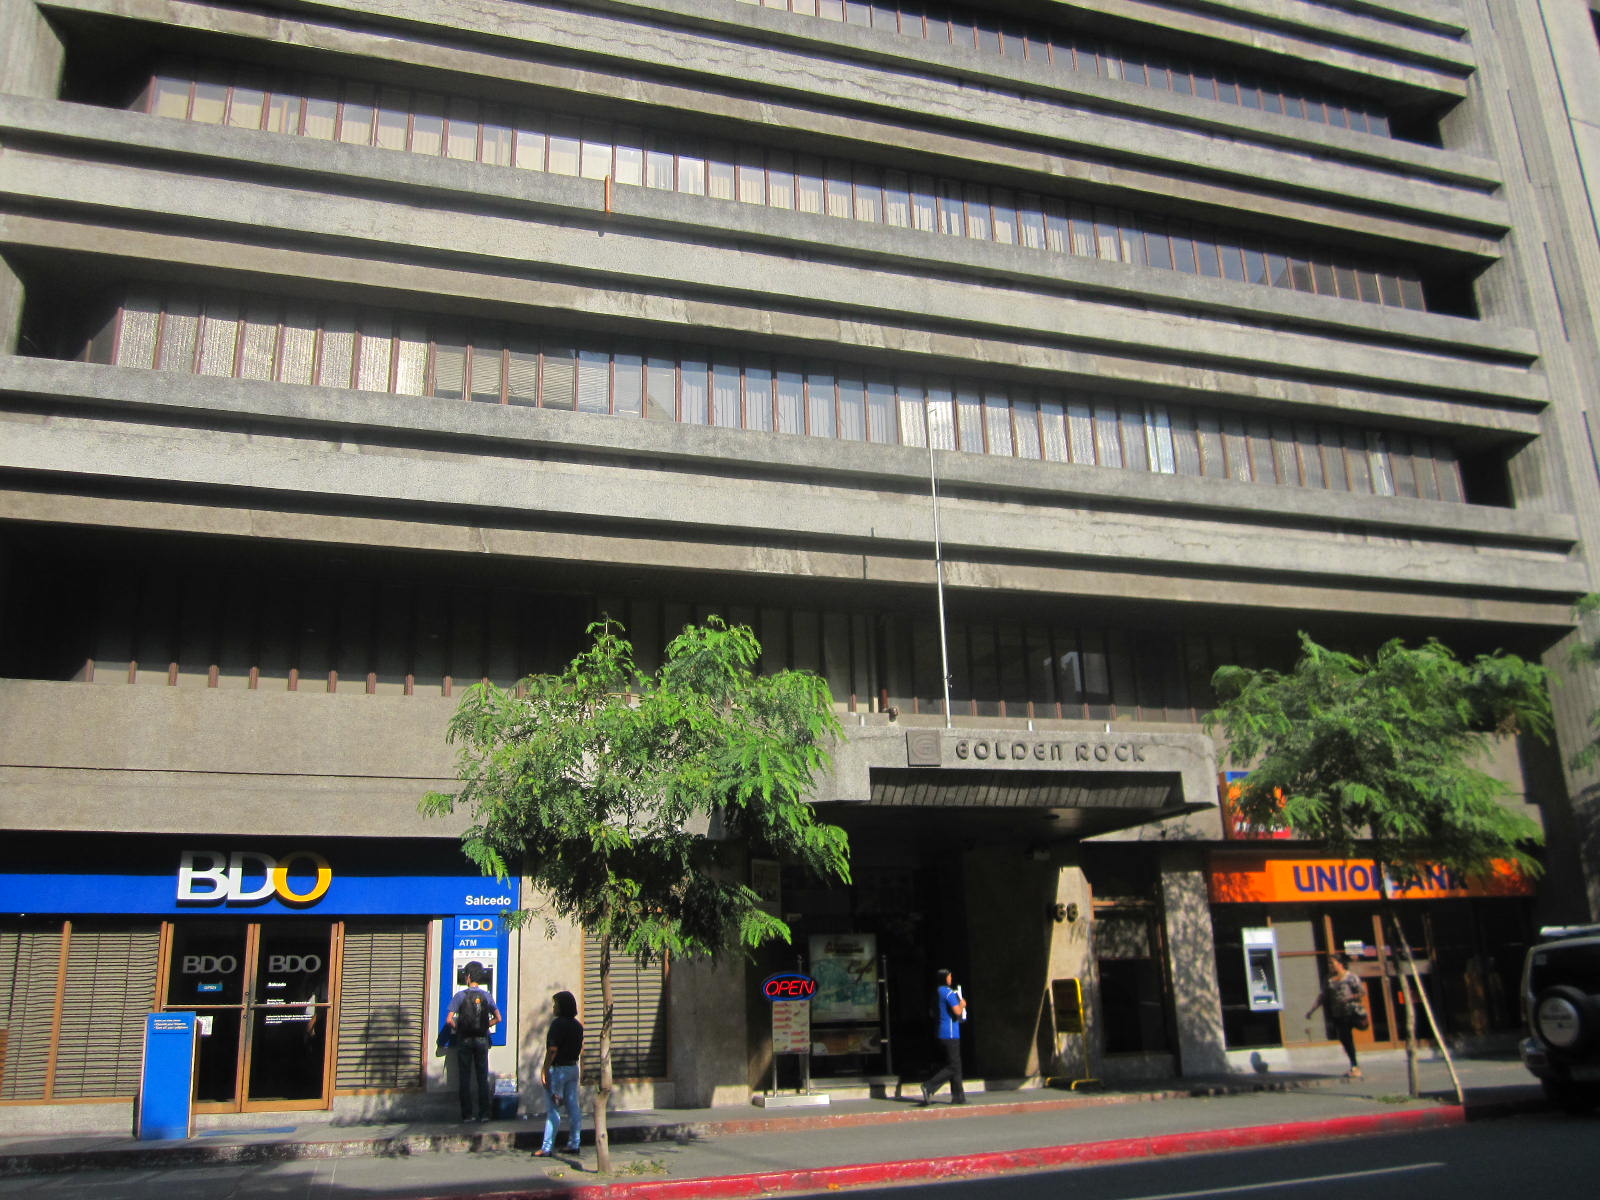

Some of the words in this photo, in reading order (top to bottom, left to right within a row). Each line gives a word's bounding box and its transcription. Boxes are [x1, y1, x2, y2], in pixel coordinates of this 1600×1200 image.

[955, 739, 1063, 761] GOLDEN
[1075, 742, 1146, 763] ROCK
[177, 850, 332, 903] BDO
[1293, 864, 1469, 893] UNIOANK
[465, 895, 511, 905] Salcedo
[459, 918, 493, 931] BDO
[459, 939, 477, 947] ATM
[182, 955, 237, 974] BDO
[268, 954, 321, 973] BDO
[765, 980, 816, 996] OPEN
